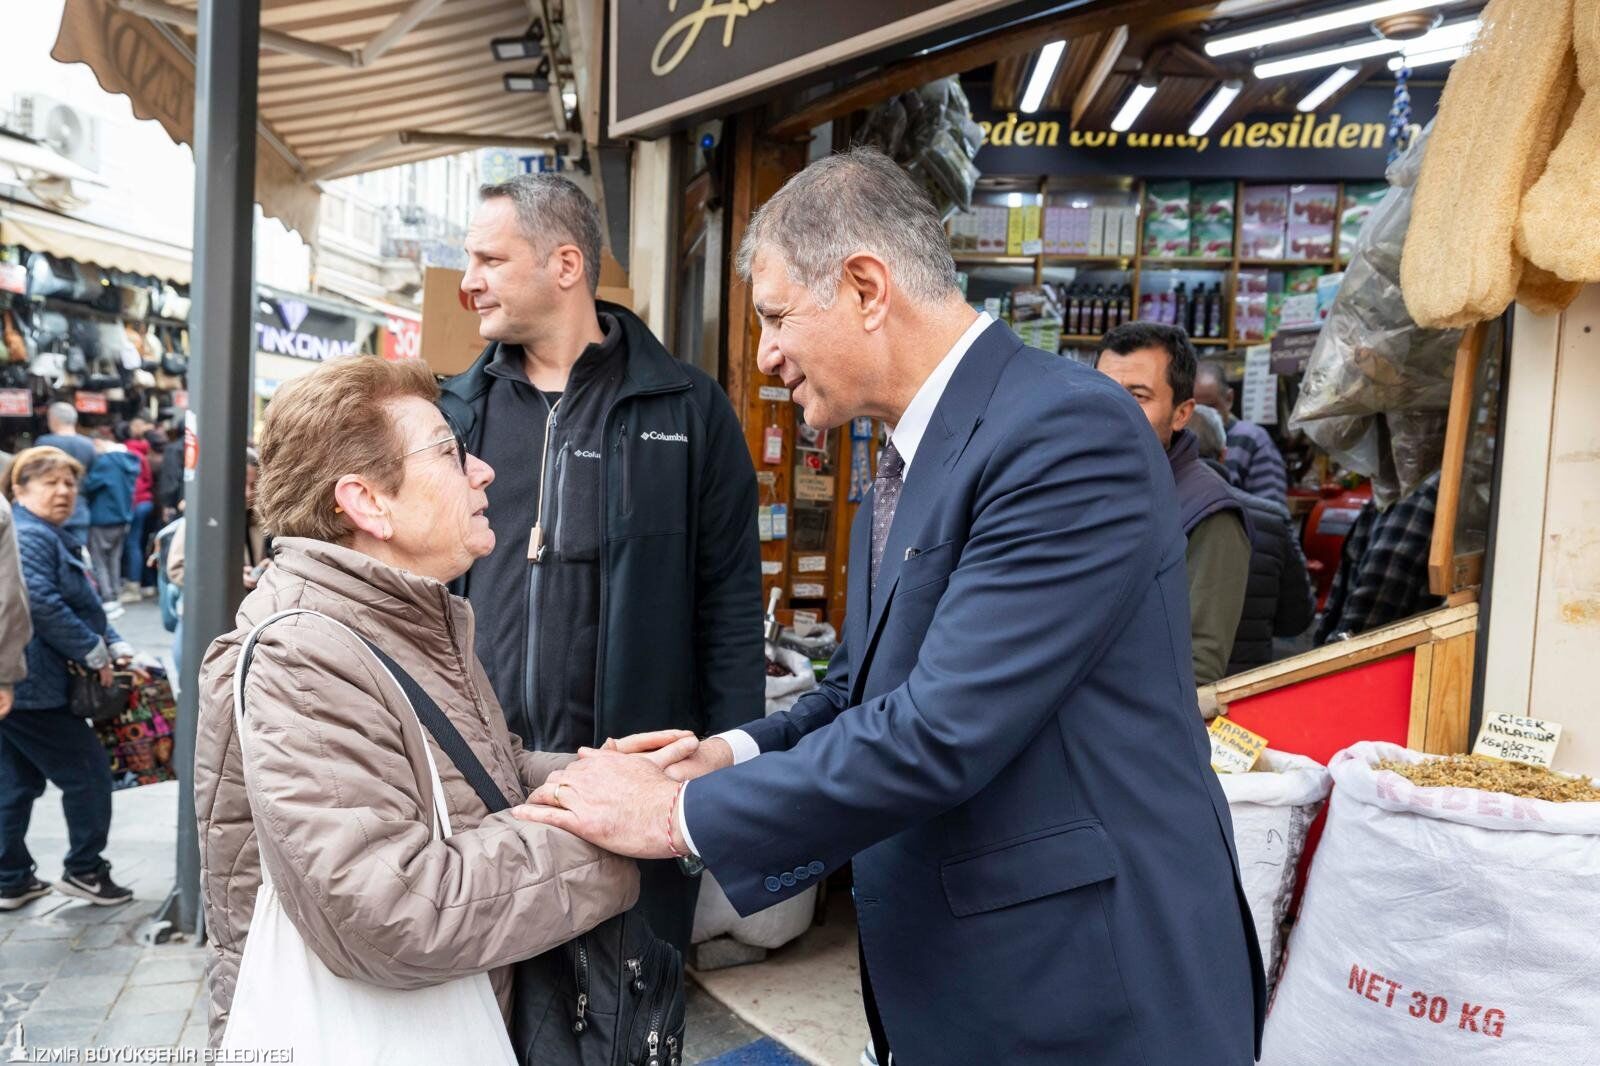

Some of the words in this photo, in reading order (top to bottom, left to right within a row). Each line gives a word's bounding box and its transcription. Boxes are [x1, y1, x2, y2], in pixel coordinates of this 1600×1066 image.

[649, 430, 688, 443] Columbia
[582, 450, 602, 459] Colu
[1348, 963, 1402, 1008] NET
[1408, 991, 1448, 1024] 30
[1458, 1002, 1506, 1038] KG
